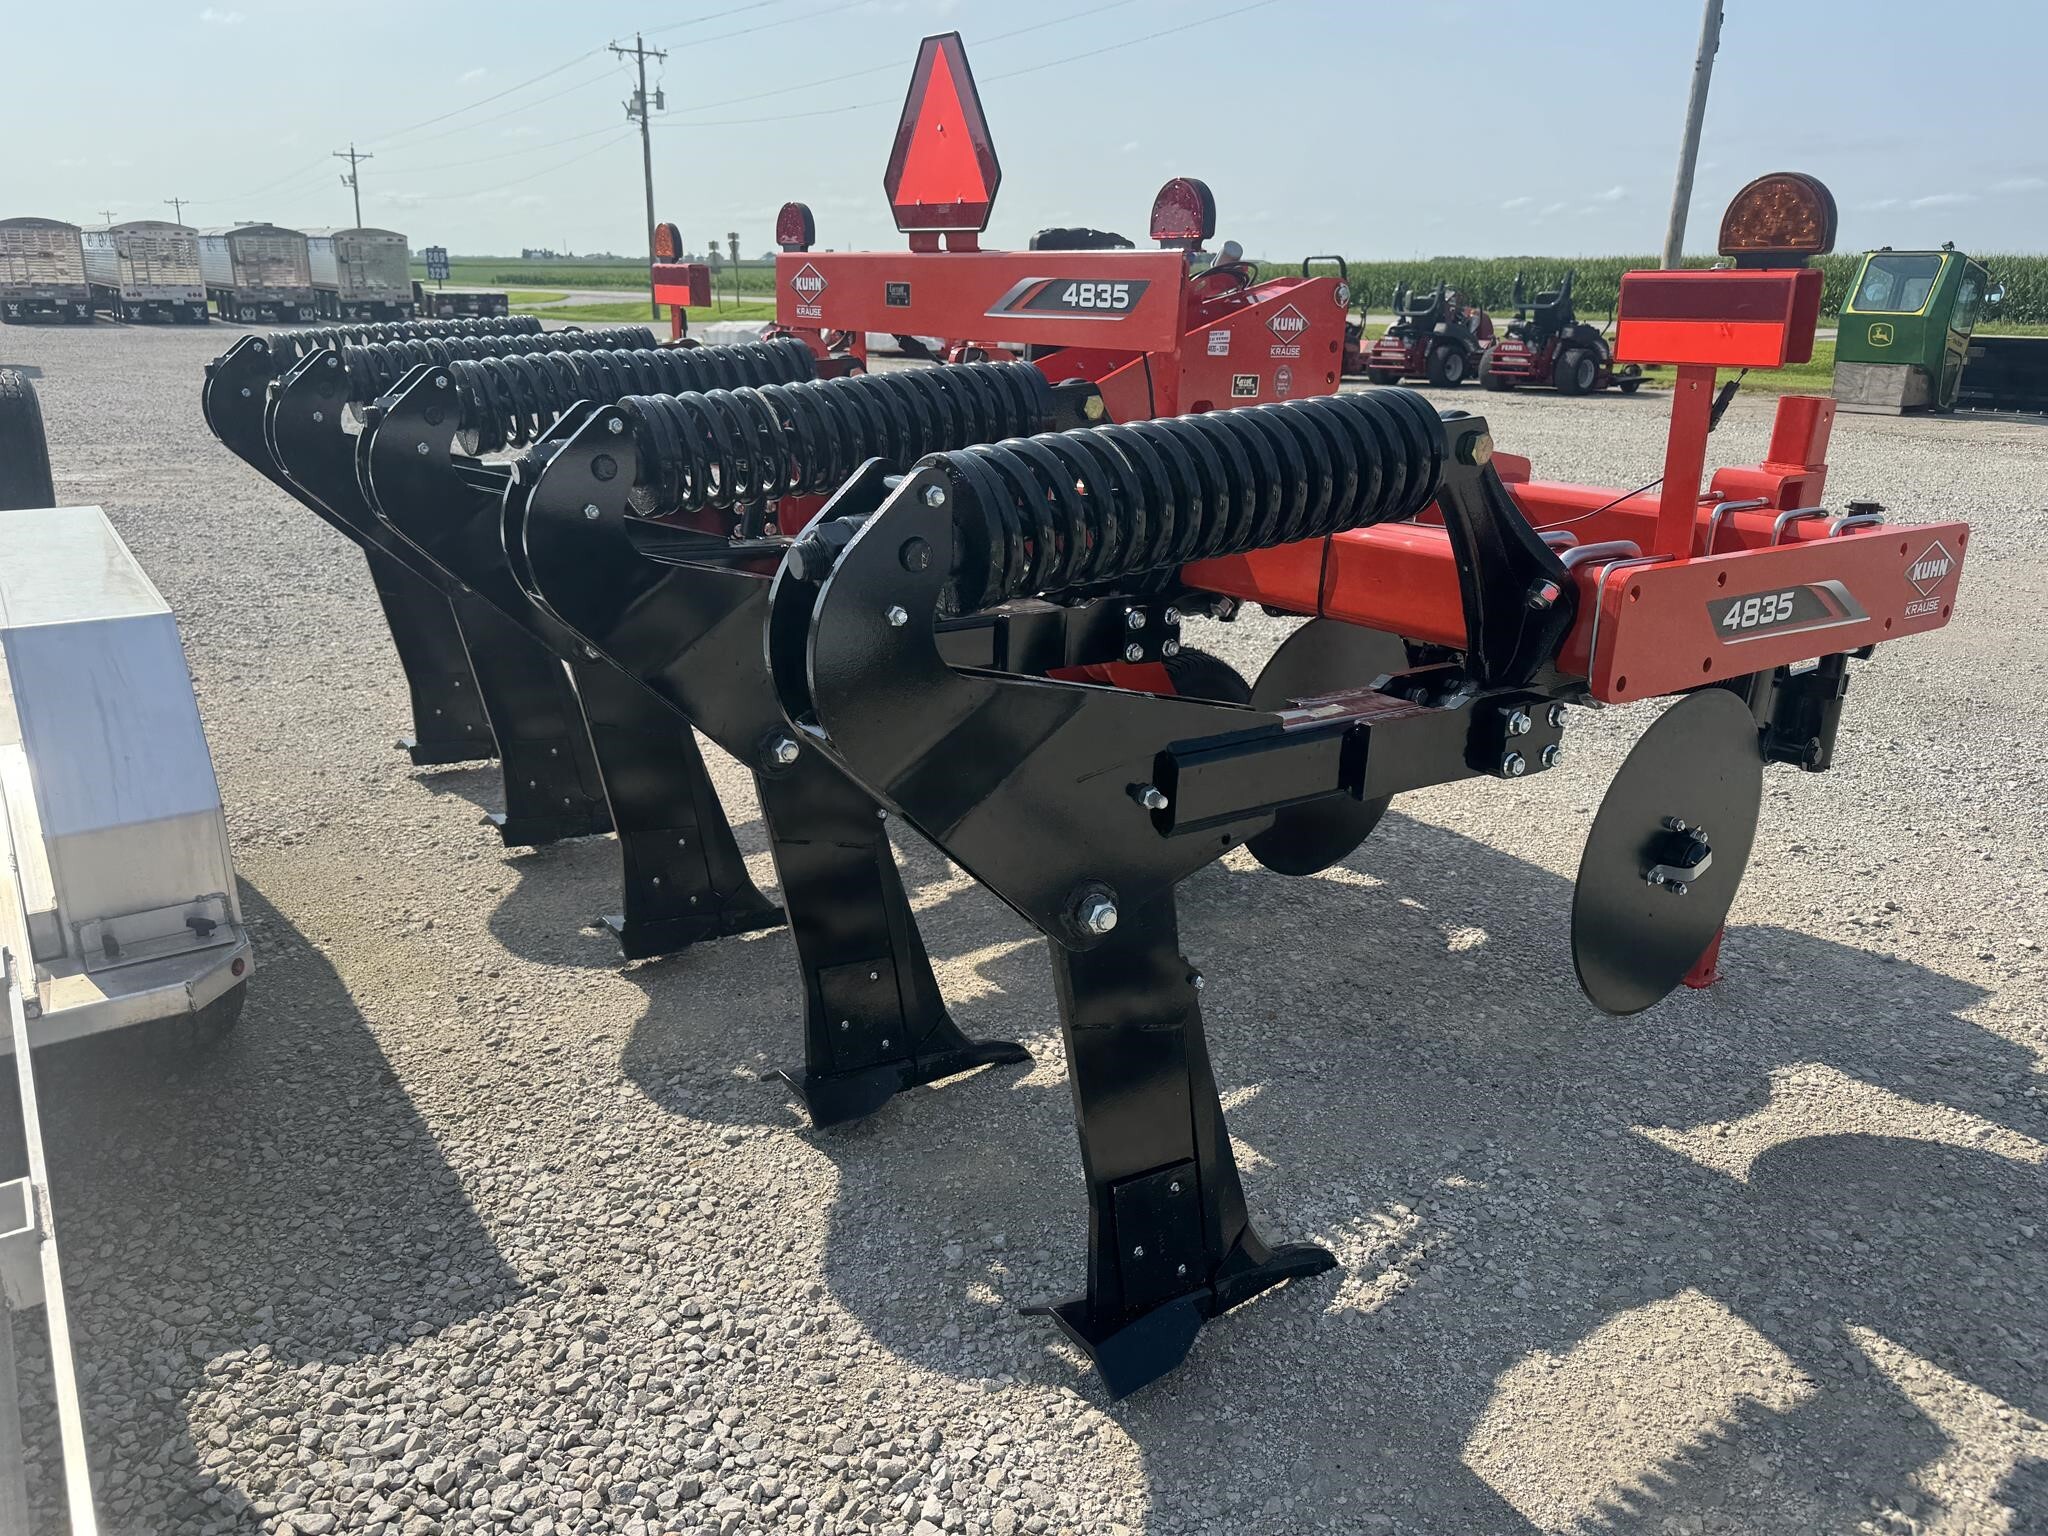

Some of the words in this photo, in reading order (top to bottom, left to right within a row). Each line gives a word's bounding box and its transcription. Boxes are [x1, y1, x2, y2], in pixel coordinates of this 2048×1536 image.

[796, 277, 822, 291] KUHN
[1062, 283, 1129, 309] 4835
[796, 307, 822, 316] KRAUSE
[1273, 317, 1304, 331] KUHN
[1270, 347, 1300, 356] KRAUSE
[1912, 558, 1949, 581] KUHN
[1722, 591, 1795, 630] 4835
[1904, 599, 1940, 616] KRAUSE
